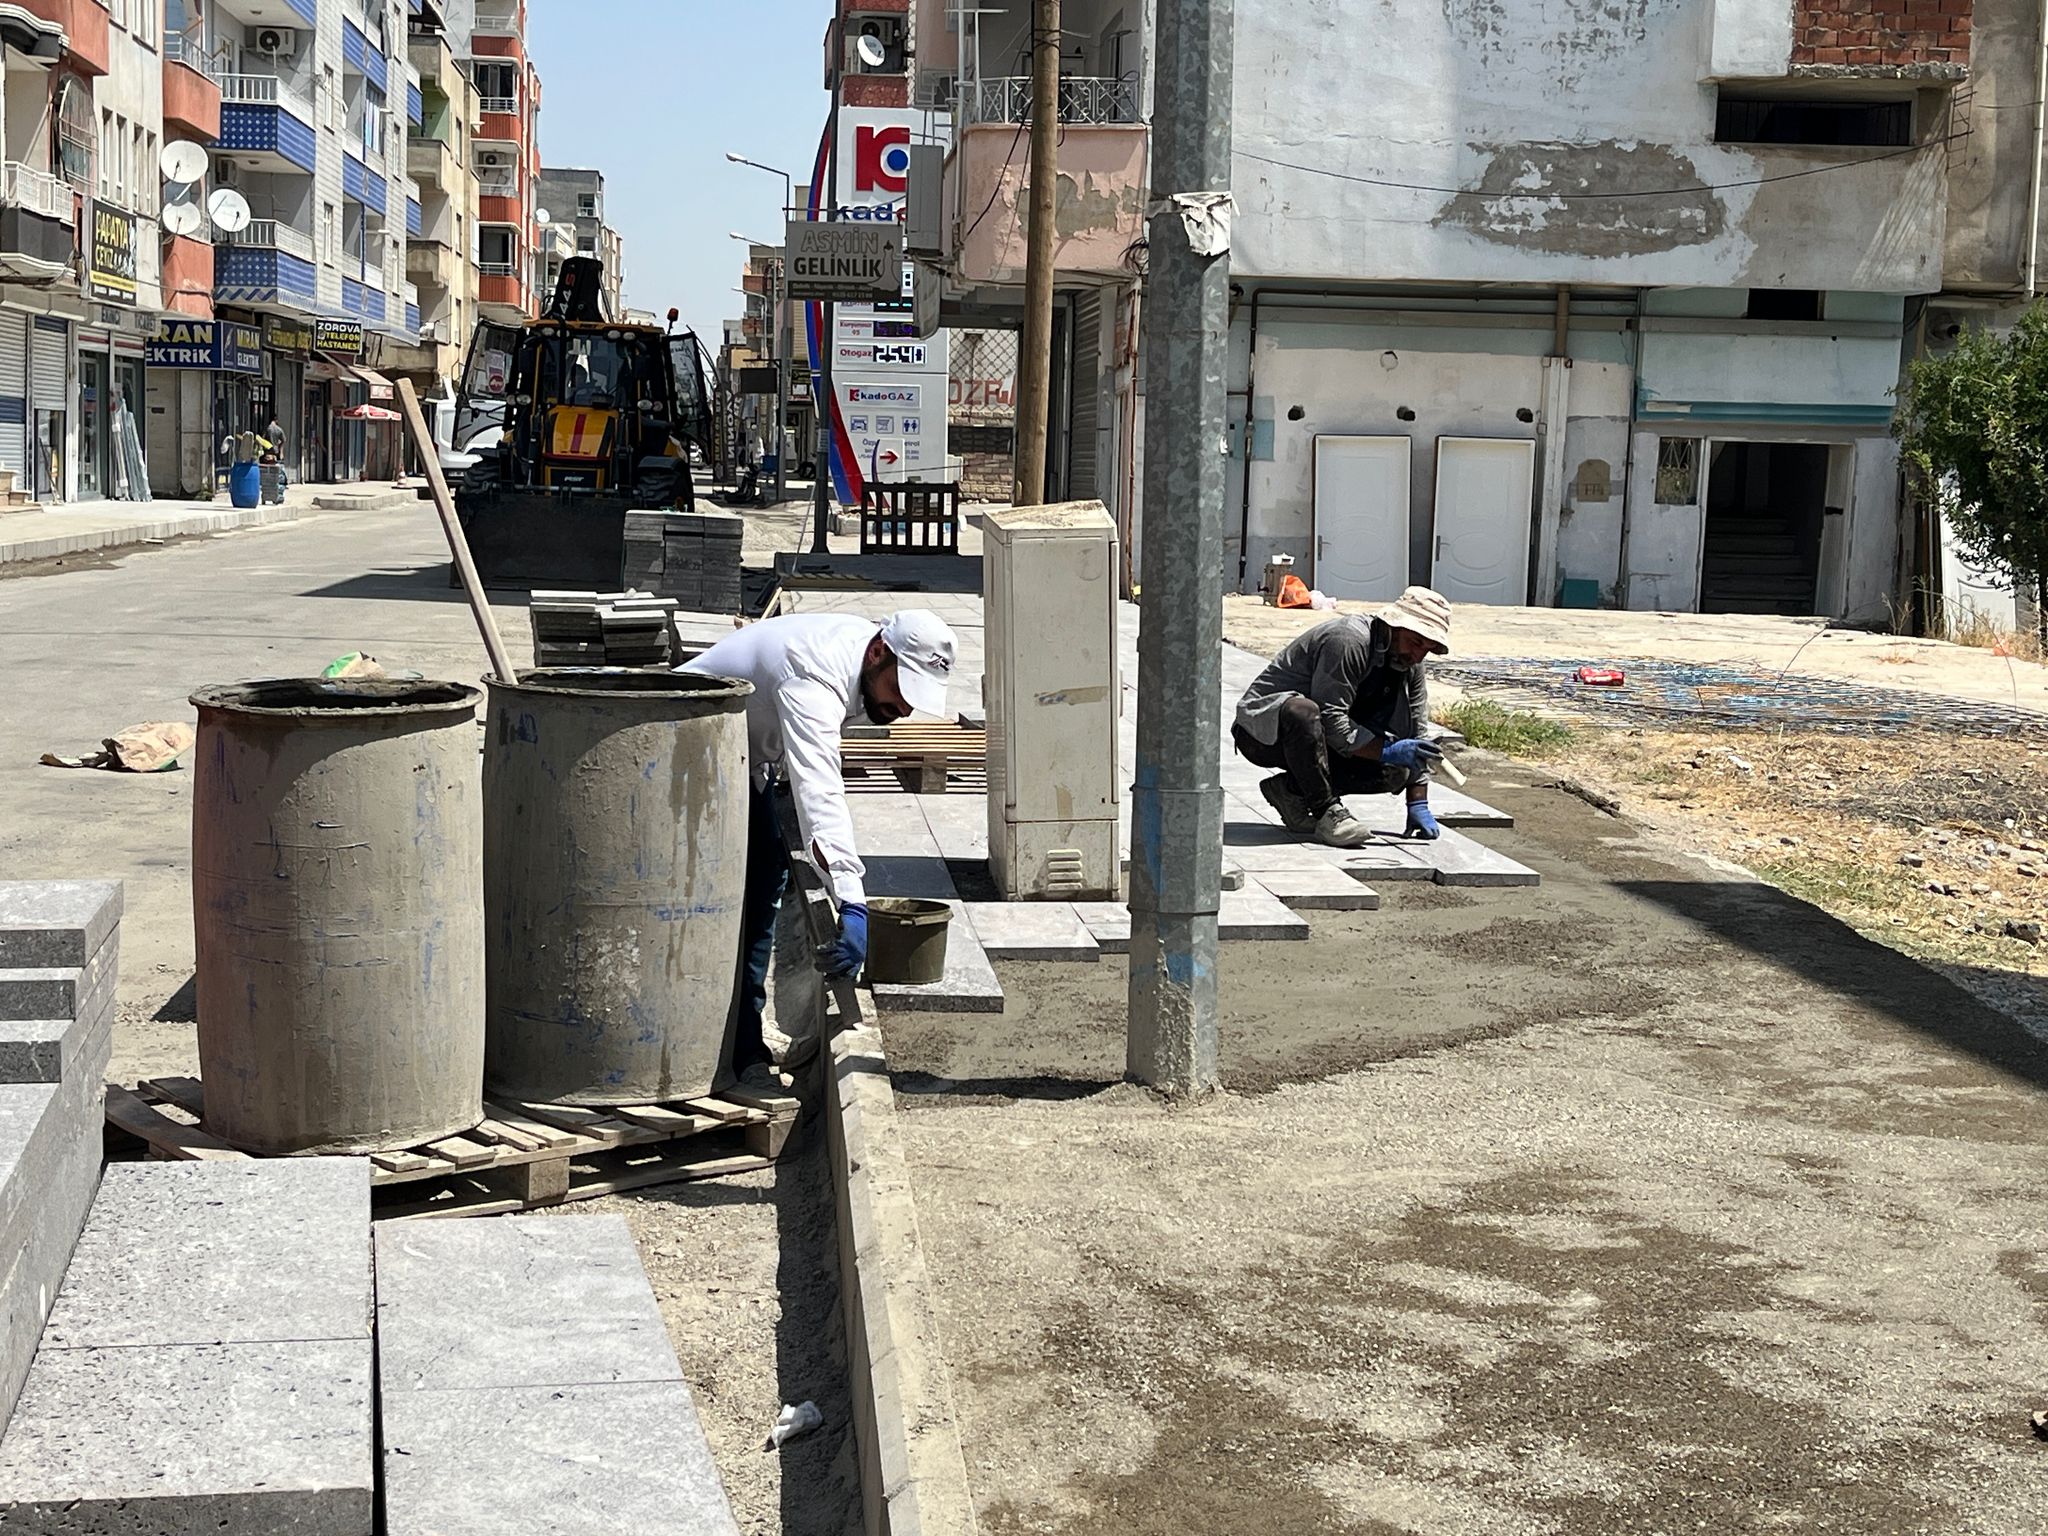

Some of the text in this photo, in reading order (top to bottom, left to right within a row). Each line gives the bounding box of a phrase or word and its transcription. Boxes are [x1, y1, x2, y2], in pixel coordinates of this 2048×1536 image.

[96, 209, 129, 250] PAPATYA
[801, 226, 879, 254] ASMİN
[794, 254, 882, 277] GELİNLİK
[317, 322, 360, 333] ZOROVA
[326, 332, 360, 341] TELEFON
[840, 348, 873, 358] Otogaz
